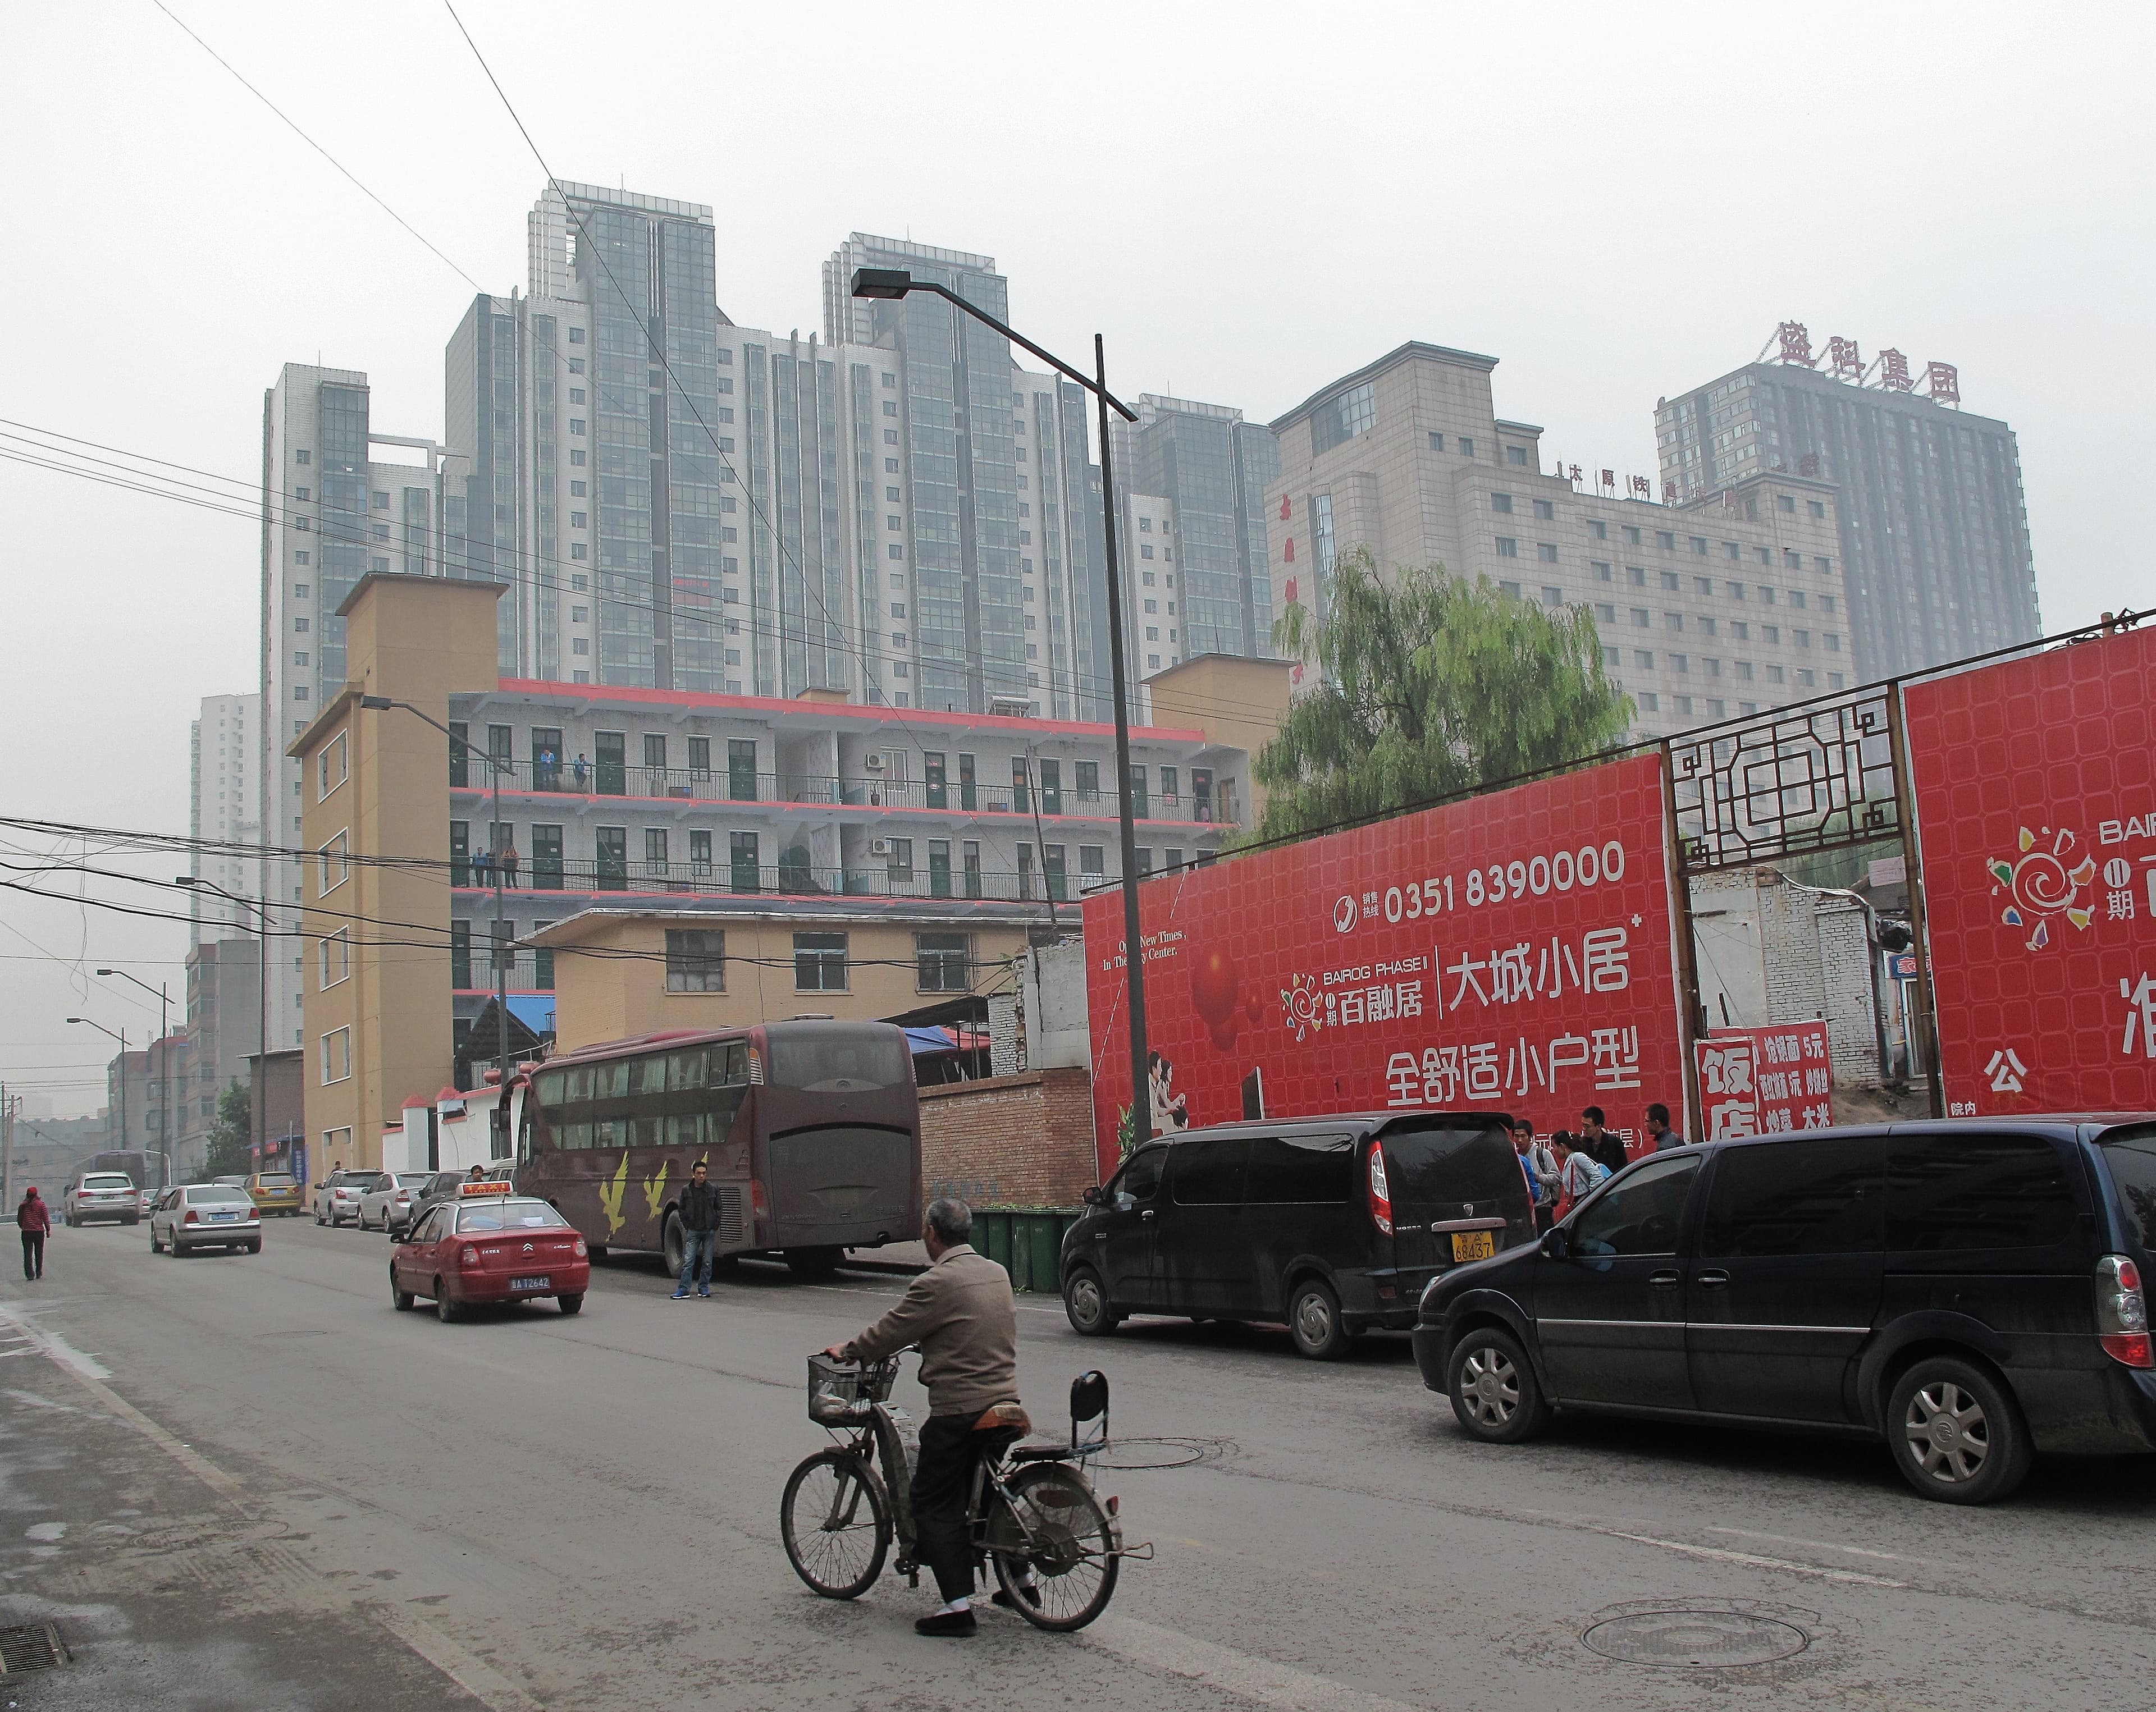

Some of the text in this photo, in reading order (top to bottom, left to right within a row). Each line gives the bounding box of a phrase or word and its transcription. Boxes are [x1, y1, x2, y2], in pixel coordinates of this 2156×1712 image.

[1385, 841, 1625, 923] 0351 8390000
[1363, 904, 1380, 919] 热线
[1103, 959, 1112, 971] In
[1323, 965, 1371, 986] BAIROG
[1446, 927, 1629, 1011] 大城小居
[1339, 979, 1423, 1026] 百融居
[1803, 1033, 1824, 1059] 5元
[1386, 1026, 1641, 1107] 全舒适小户型
[1984, 1048, 2028, 1093] 公
[1802, 1102, 1830, 1130] 大米
[1951, 1101, 1976, 1116] 院内
[467, 1183, 506, 1191] TAXI
[1456, 1242, 1490, 1260] 68437
